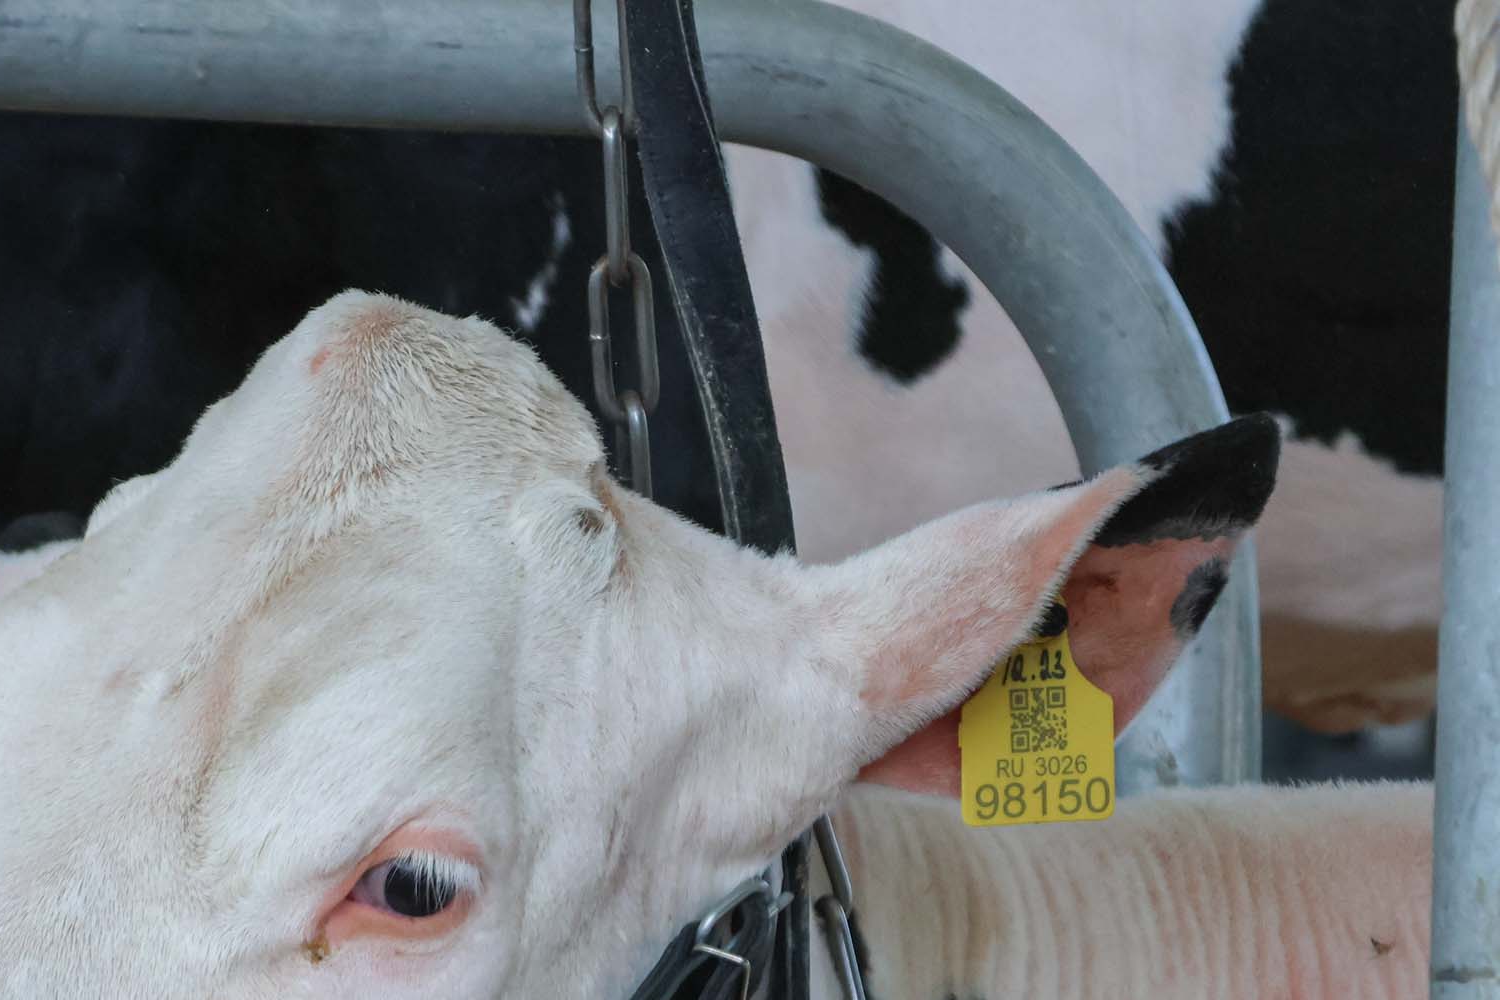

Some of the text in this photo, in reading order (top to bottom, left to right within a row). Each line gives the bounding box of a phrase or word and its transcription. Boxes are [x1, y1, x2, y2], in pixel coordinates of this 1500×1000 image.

[996, 755, 1088, 778] RU 3026
[975, 777, 1111, 820] 98150
